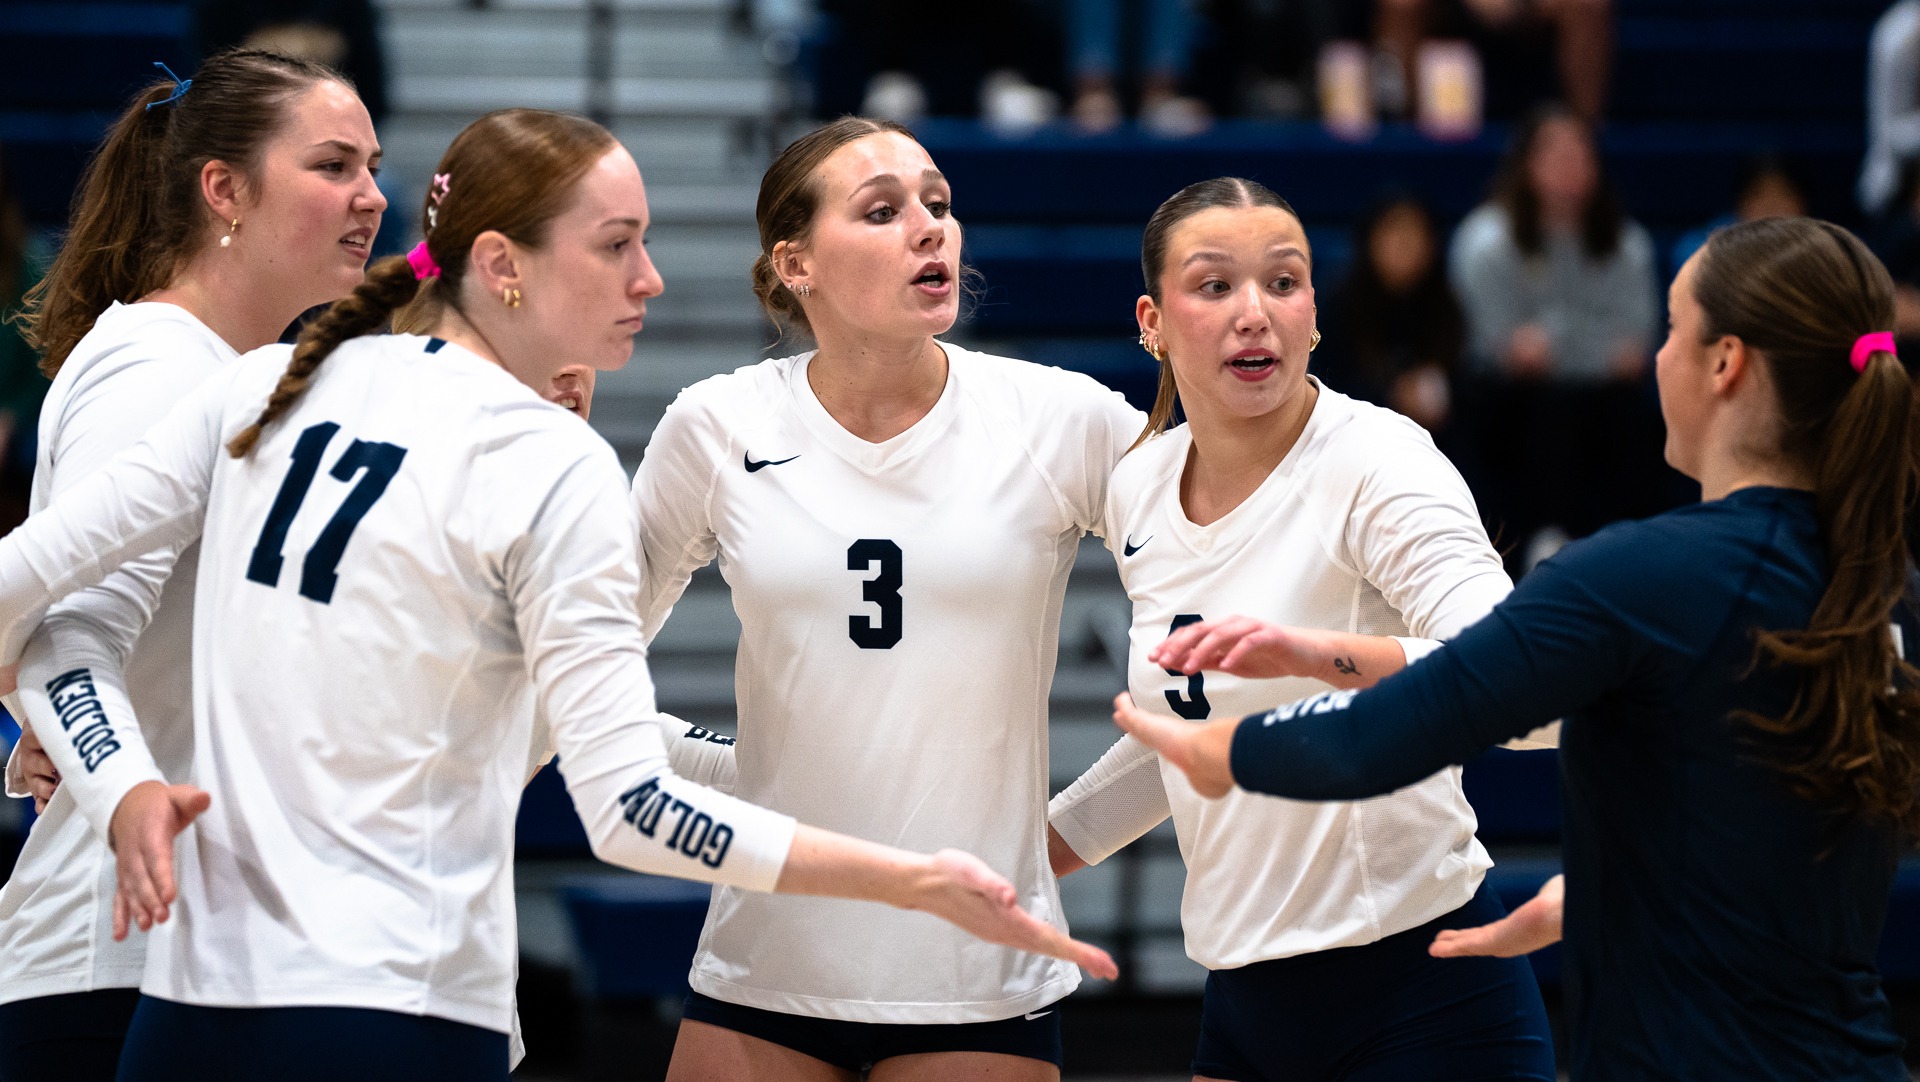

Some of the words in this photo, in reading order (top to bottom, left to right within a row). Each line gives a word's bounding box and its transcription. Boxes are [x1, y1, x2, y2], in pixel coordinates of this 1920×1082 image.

[247, 421, 408, 605] 17
[847, 539, 904, 650] 3
[46, 667, 122, 774] GOLDEN
